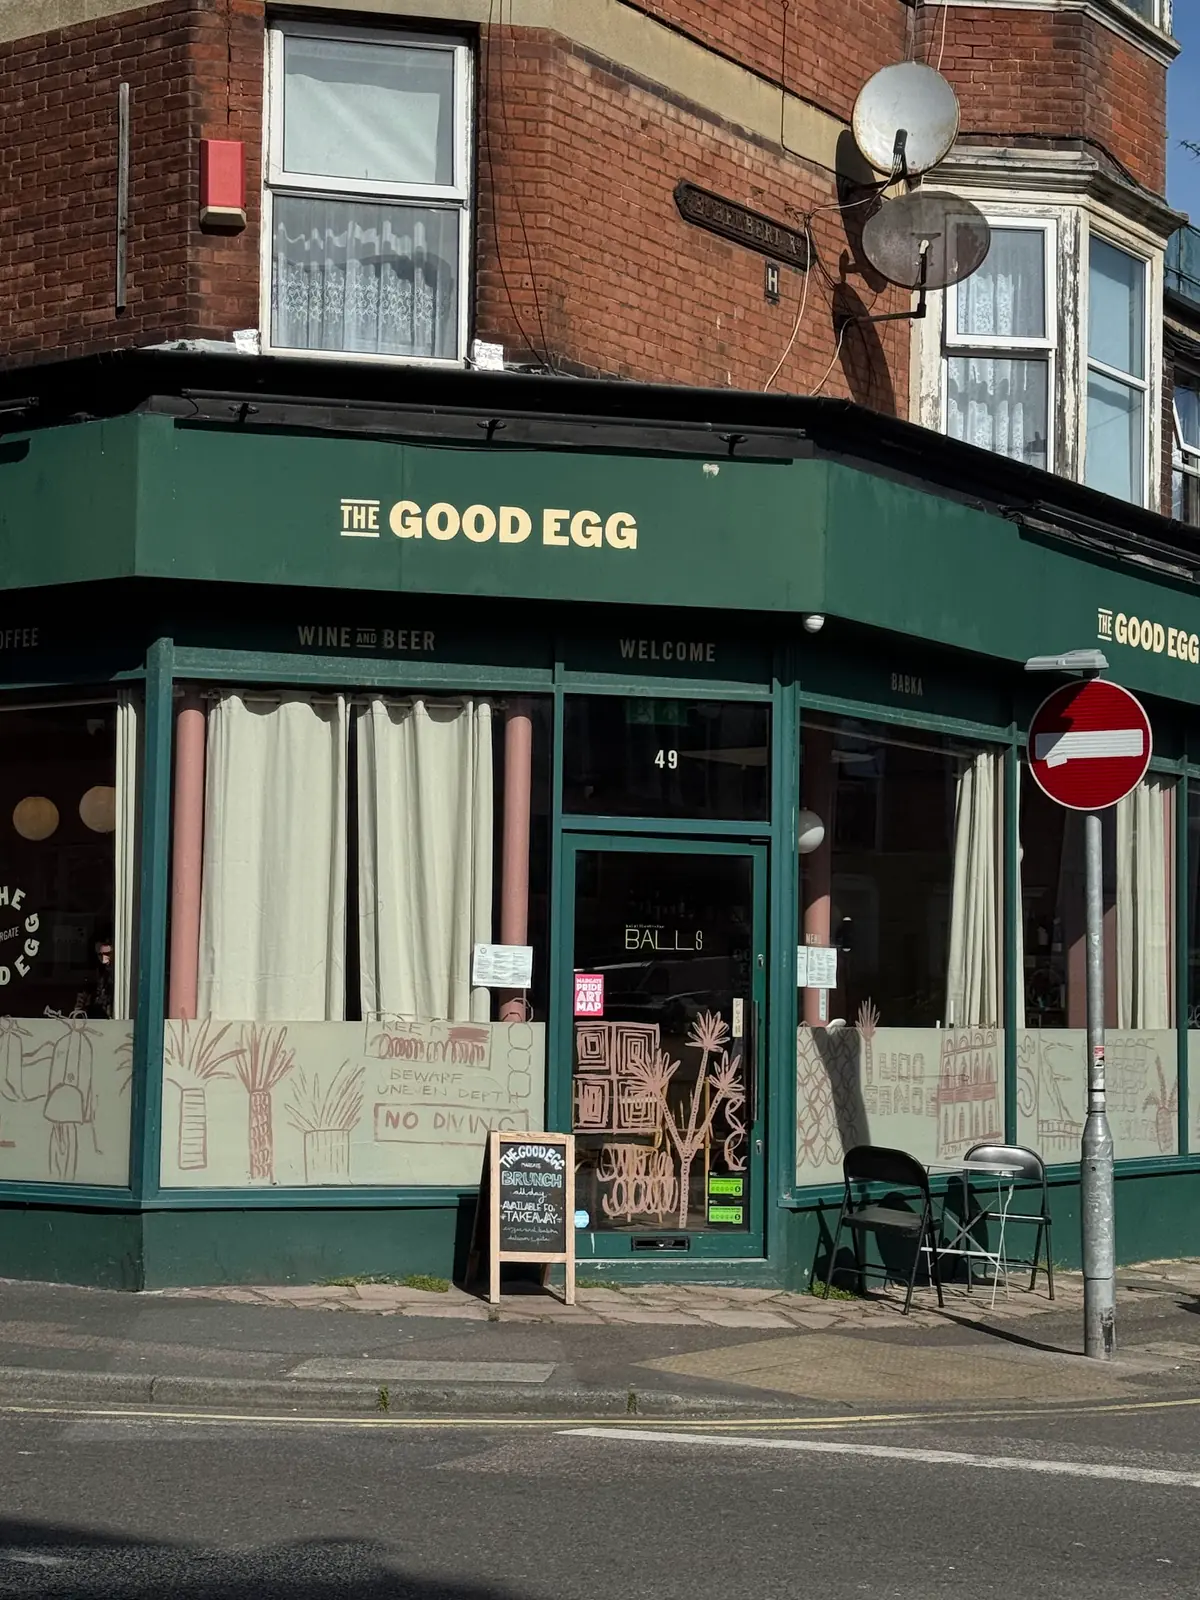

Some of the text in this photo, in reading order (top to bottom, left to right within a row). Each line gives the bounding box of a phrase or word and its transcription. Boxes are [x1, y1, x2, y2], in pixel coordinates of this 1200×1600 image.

[768, 267, 778, 294] H
[340, 500, 638, 550] THE GOOD EGG
[298, 625, 436, 651] WINE AND BEER
[1098, 612, 1200, 664] THE GOOD EGG
[620, 638, 716, 662] WELCOME
[891, 672, 923, 696] BABKA
[654, 749, 678, 769] 49
[625, 928, 703, 951] BALLS
[576, 983, 602, 992] PRIDE
[577, 991, 602, 1002] ART
[576, 1002, 602, 1012] MAP
[458, 1088, 520, 1104] DEPTH
[385, 1110, 516, 1135] NO DIVING
[499, 1147, 520, 1169] THE
[518, 1145, 546, 1159] GOOD
[501, 1170, 563, 1189] BRUNCH
[503, 1210, 558, 1225] TAKEAWAY
